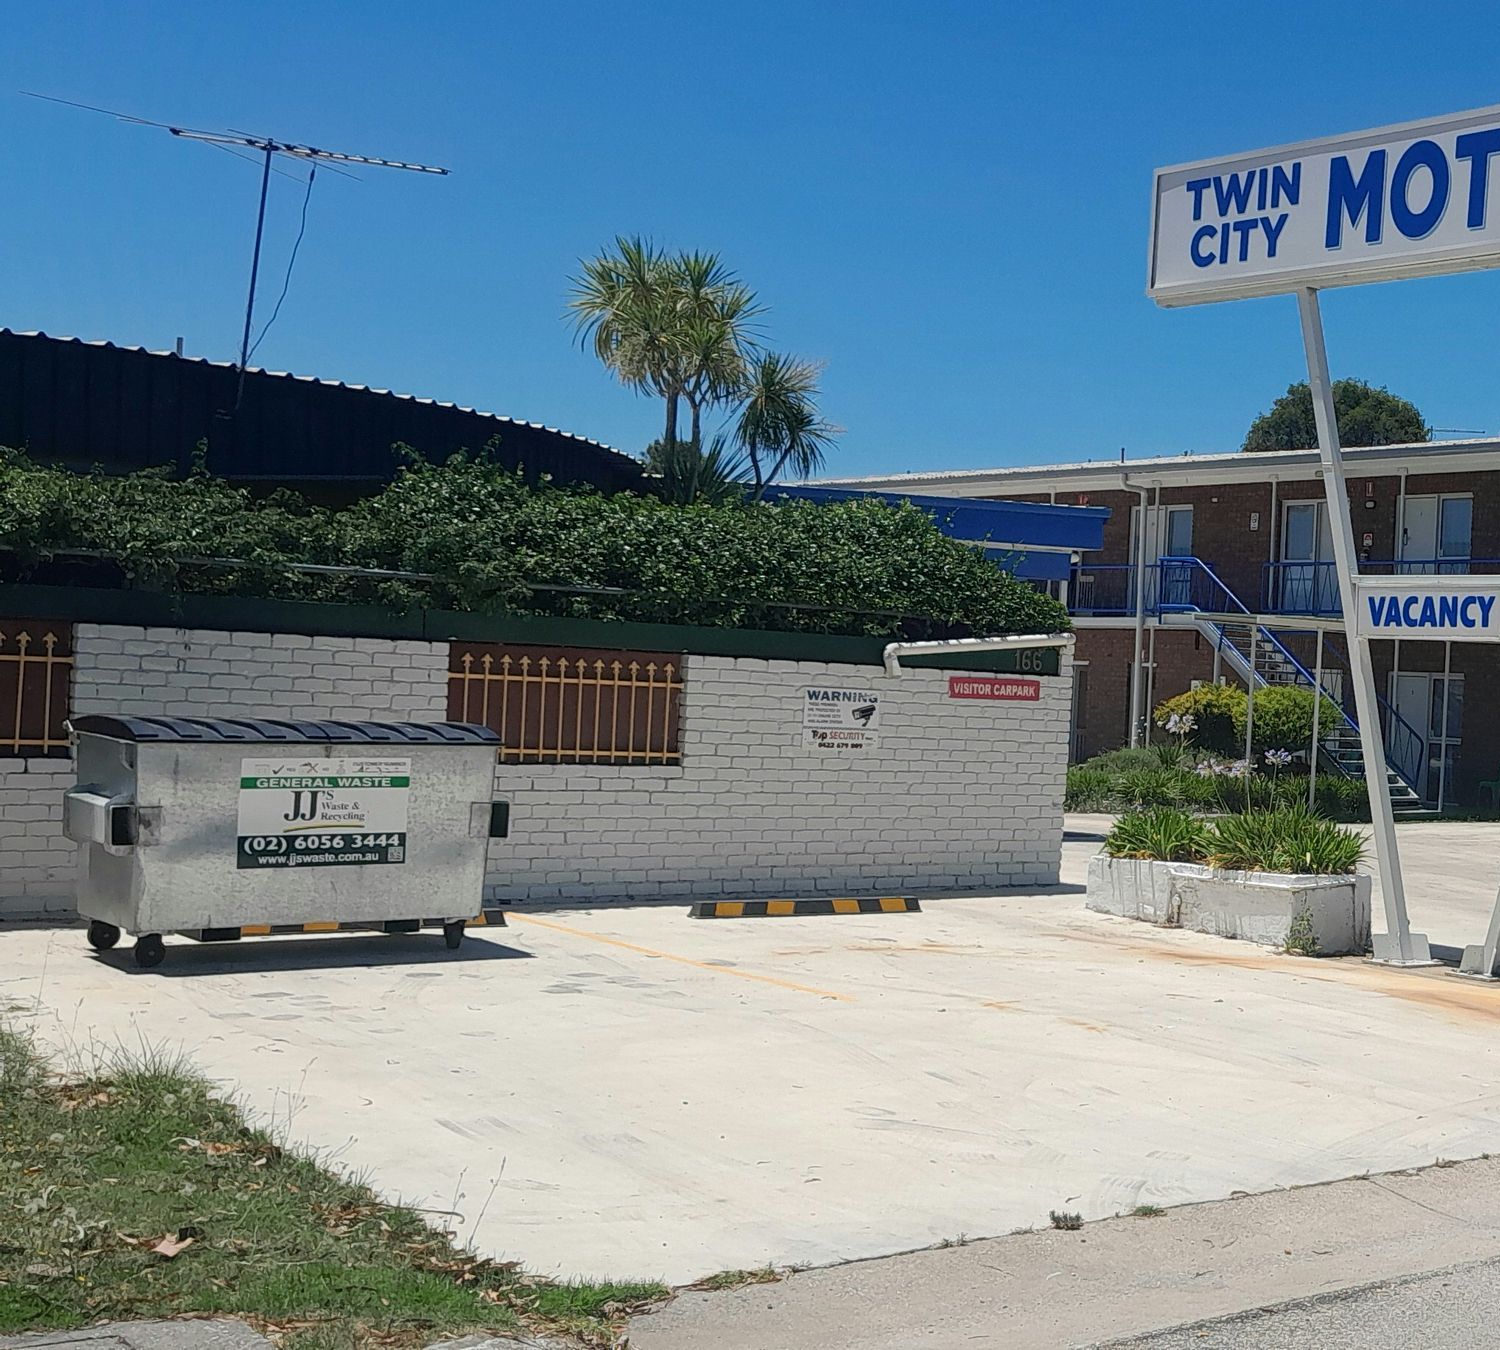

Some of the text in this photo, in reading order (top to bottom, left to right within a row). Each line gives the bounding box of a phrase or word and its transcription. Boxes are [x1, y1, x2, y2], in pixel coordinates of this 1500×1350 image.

[1186, 161, 1302, 222] TWIN
[1190, 212, 1290, 268] CITY
[1367, 595, 1497, 628] VACANCY
[1015, 648, 1043, 671] 166
[807, 689, 878, 704] WARNING
[953, 682, 1036, 697] VISITOR CARPARK
[256, 777, 392, 788] GENERAL WASTE
[321, 801, 360, 810] Waste &
[320, 812, 365, 822] Recycling
[243, 834, 400, 854] (02) 6056 3444
[257, 851, 379, 866] www.jjswaste.com.au
